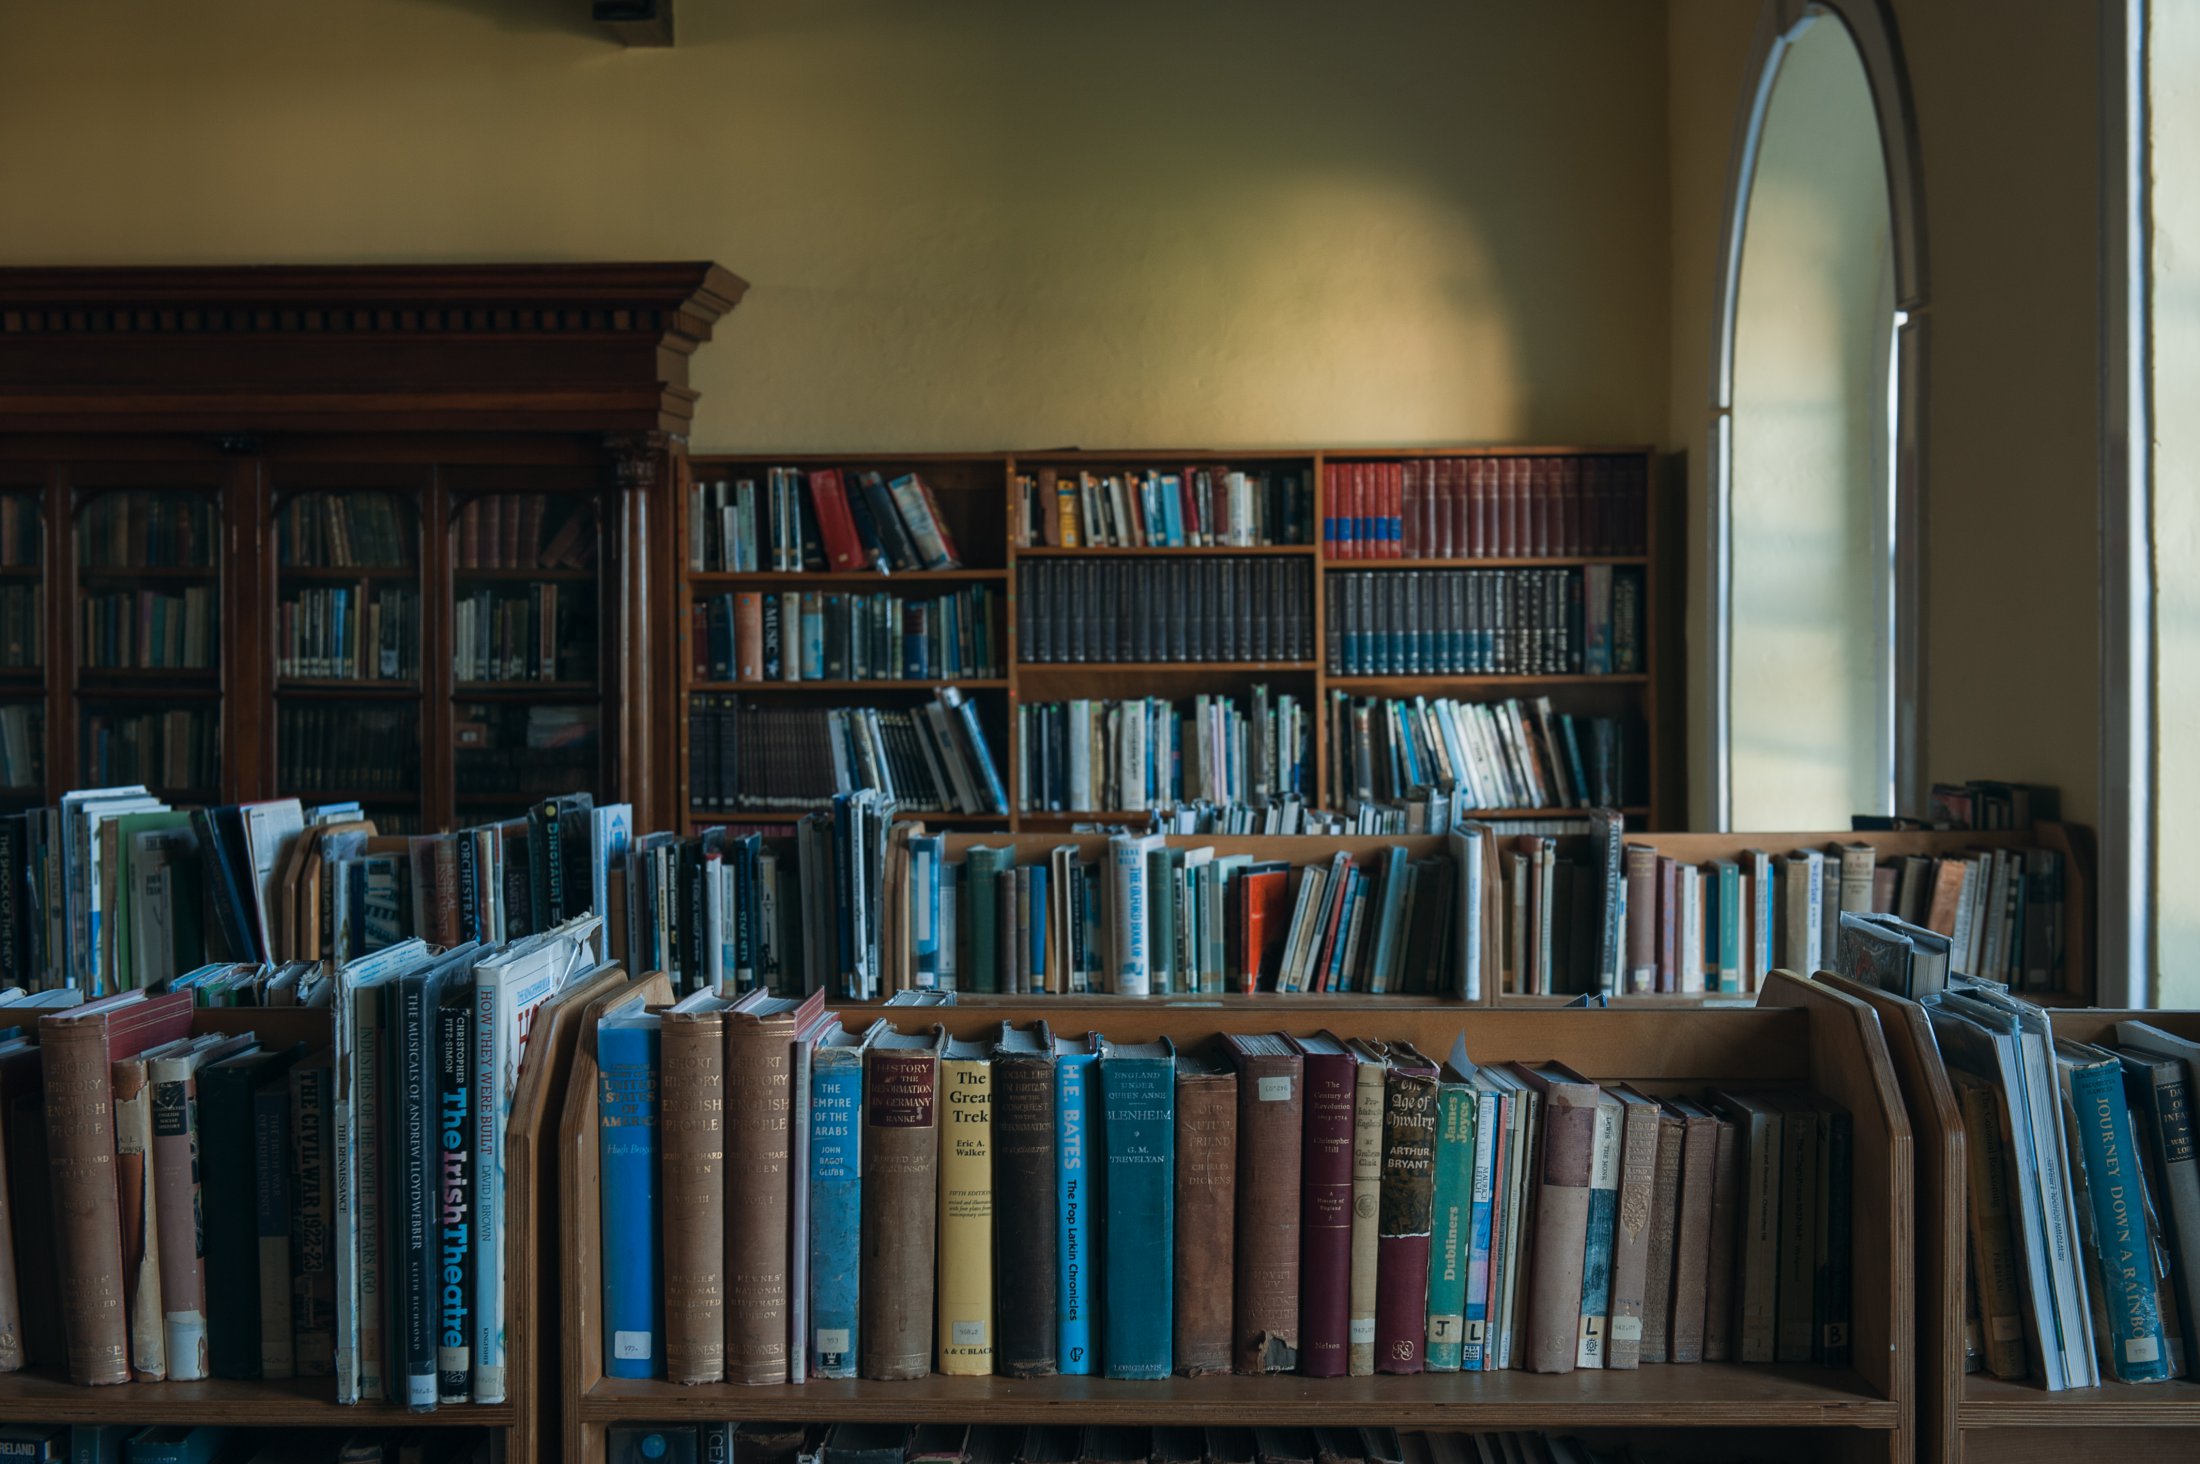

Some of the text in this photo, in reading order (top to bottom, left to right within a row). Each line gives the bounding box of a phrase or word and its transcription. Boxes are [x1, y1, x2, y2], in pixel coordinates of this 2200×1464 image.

[765, 606, 779, 655] MUSIC
[447, 862, 458, 911] MUSICAL
[508, 873, 520, 914] MARTIN
[1, 834, 12, 968] THE SHOCK OF THE NEW
[1130, 866, 1144, 957] THE OXFORD BOOK OF
[740, 911, 748, 938] STAGE
[408, 993, 418, 1020] THE
[408, 1021, 420, 1082] MUSICALS
[444, 1018, 454, 1073] FITZ-SIMON
[456, 1016, 465, 1084] CHRISTOPHER
[360, 1026, 376, 1100] INDUSTRIES
[668, 1056, 712, 1068] SHORT
[737, 1056, 782, 1068] SHORT
[876, 1063, 930, 1074] HISTORY
[480, 989, 493, 1155] HOW THEY WERE BUILT
[956, 1072, 986, 1084] The
[1114, 1072, 1160, 1080] ENGLAND
[48, 1078, 104, 1092] HISTORY
[605, 1079, 657, 1090] UNITED
[664, 1074, 720, 1087] HISTORY
[733, 1074, 788, 1087] HISTORY
[408, 1084, 420, 1100] OF
[822, 1084, 841, 1094] THE
[870, 1084, 932, 1094] REFORMATION
[1108, 1092, 1166, 1100] QUEEN ANNE
[1314, 1092, 1342, 1101] Century
[606, 1092, 656, 1103] STATES
[662, 1098, 722, 1112] ENGLISH
[729, 1098, 790, 1112] ENGLISH
[814, 1098, 852, 1108] EMPIRE
[872, 1096, 932, 1107] IN GERMANY
[950, 1091, 991, 1104] Great
[1392, 1095, 1430, 1112] Age of
[48, 1103, 107, 1118] ENGLISH
[361, 1103, 376, 1119] OF
[953, 1110, 988, 1122] Trek
[1063, 1064, 1081, 1169] H.E. BATES
[1107, 1109, 1171, 1120] BLENHEIM
[1200, 1104, 1224, 1114] OUR
[442, 1088, 467, 1150] The
[815, 1112, 848, 1122] OF THE
[886, 1114, 916, 1123] RANKE
[1356, 1118, 1382, 1130] England
[1386, 1113, 1434, 1132] Chivalry
[1444, 1097, 1458, 1143] James
[1456, 1102, 1469, 1143] Joyce
[271, 1113, 280, 1138] THE
[408, 1104, 420, 1158] ANDREW
[666, 1118, 719, 1132] PEOPLE
[733, 1118, 787, 1132] PEOPLE
[815, 1126, 848, 1136] ARABS
[1184, 1120, 1234, 1130] MUTUAL
[362, 1124, 376, 1148] THE
[1984, 1112, 1996, 1154] Colonial
[2096, 1098, 2120, 1178] JOURNEY
[956, 1140, 974, 1148] Eric
[1190, 1136, 1231, 1146] FRIEND
[1314, 1137, 1350, 1145] Christopher
[821, 1146, 841, 1154] JOHN
[1128, 1146, 1149, 1154] G. M.
[1390, 1146, 1430, 1156] ARTHUR
[1602, 1144, 1610, 1160] THE
[819, 1157, 844, 1166] BAGOT
[1110, 1156, 1164, 1164] TREVELYAN
[1388, 1159, 1430, 1169] BRYANT
[302, 1071, 322, 1271] THE CIVIL WAR 1922-23
[819, 1168, 844, 1176] GLUBB
[338, 1146, 346, 1214] RENAISSANCE
[443, 1150, 468, 1224] Irish
[1189, 1176, 1231, 1184] DICKENS
[480, 1163, 491, 1242] DAVID BROWN
[2050, 1193, 2060, 1222] SCHOOL
[2112, 1186, 2129, 1244] DOWN
[362, 1224, 376, 1264] YEARS
[1066, 1179, 1078, 1321] The Pop Larkin Chronicles
[1444, 1206, 1458, 1281] Dubliners
[2054, 1223, 2065, 1262] NEWTOWN
[2120, 1251, 2134, 1262] A
[362, 1269, 376, 1294] AGO
[442, 1224, 468, 1347] Theatre
[2122, 1267, 2146, 1339] RAINBO
[412, 1295, 420, 1350] RICHMOND
[1435, 1320, 1450, 1337] J
[1586, 1318, 1597, 1335] L
[1470, 1323, 1481, 1340] L
[1830, 1326, 1840, 1344] B
[1114, 1364, 1162, 1372] LONGMANS
[0, 1442, 36, 1456] RELAND
